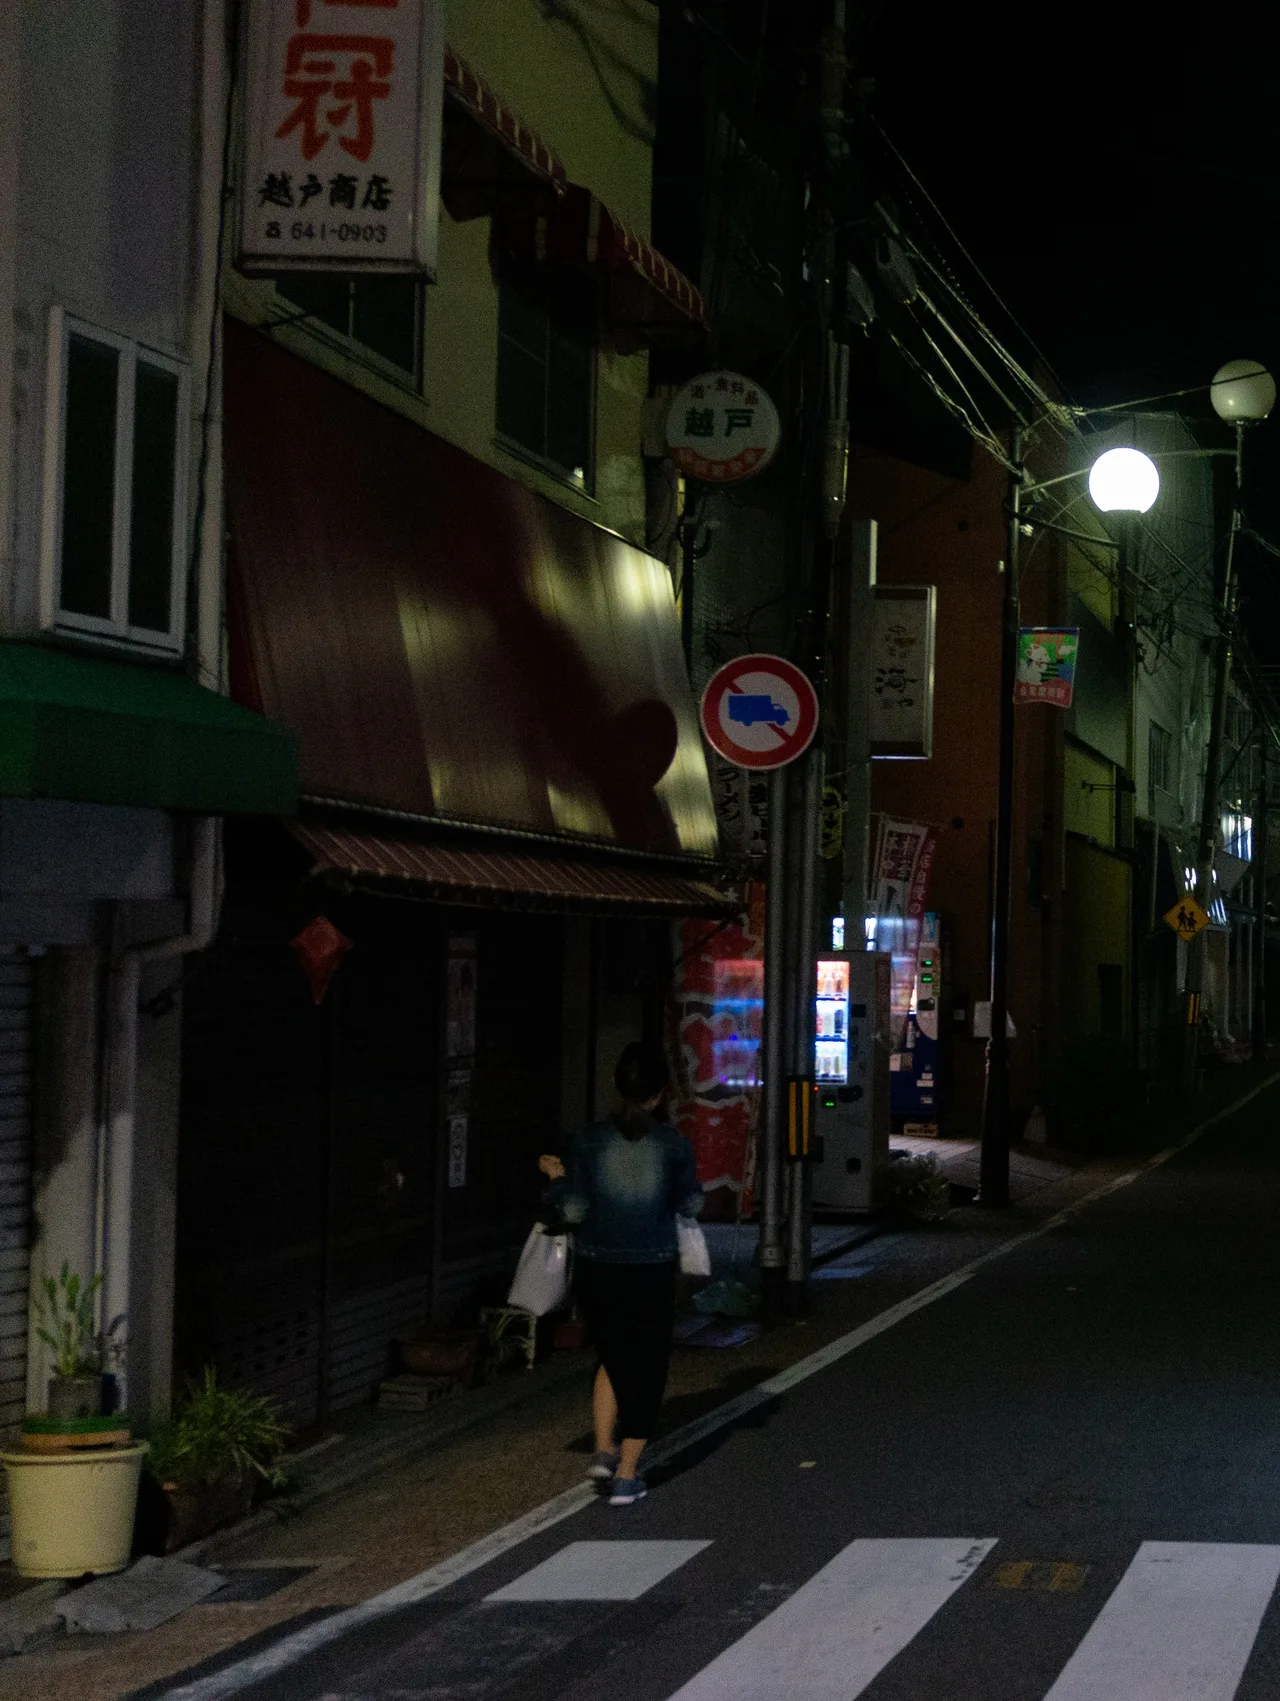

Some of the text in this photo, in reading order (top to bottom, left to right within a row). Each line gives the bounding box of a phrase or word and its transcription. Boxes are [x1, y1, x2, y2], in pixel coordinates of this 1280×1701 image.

[275, 0, 398, 162] 冠
[257, 172, 393, 212] 越戸商店
[290, 222, 389, 244] 641-0903
[685, 408, 755, 438] 越戸
[717, 767, 740, 822] ラーメン
